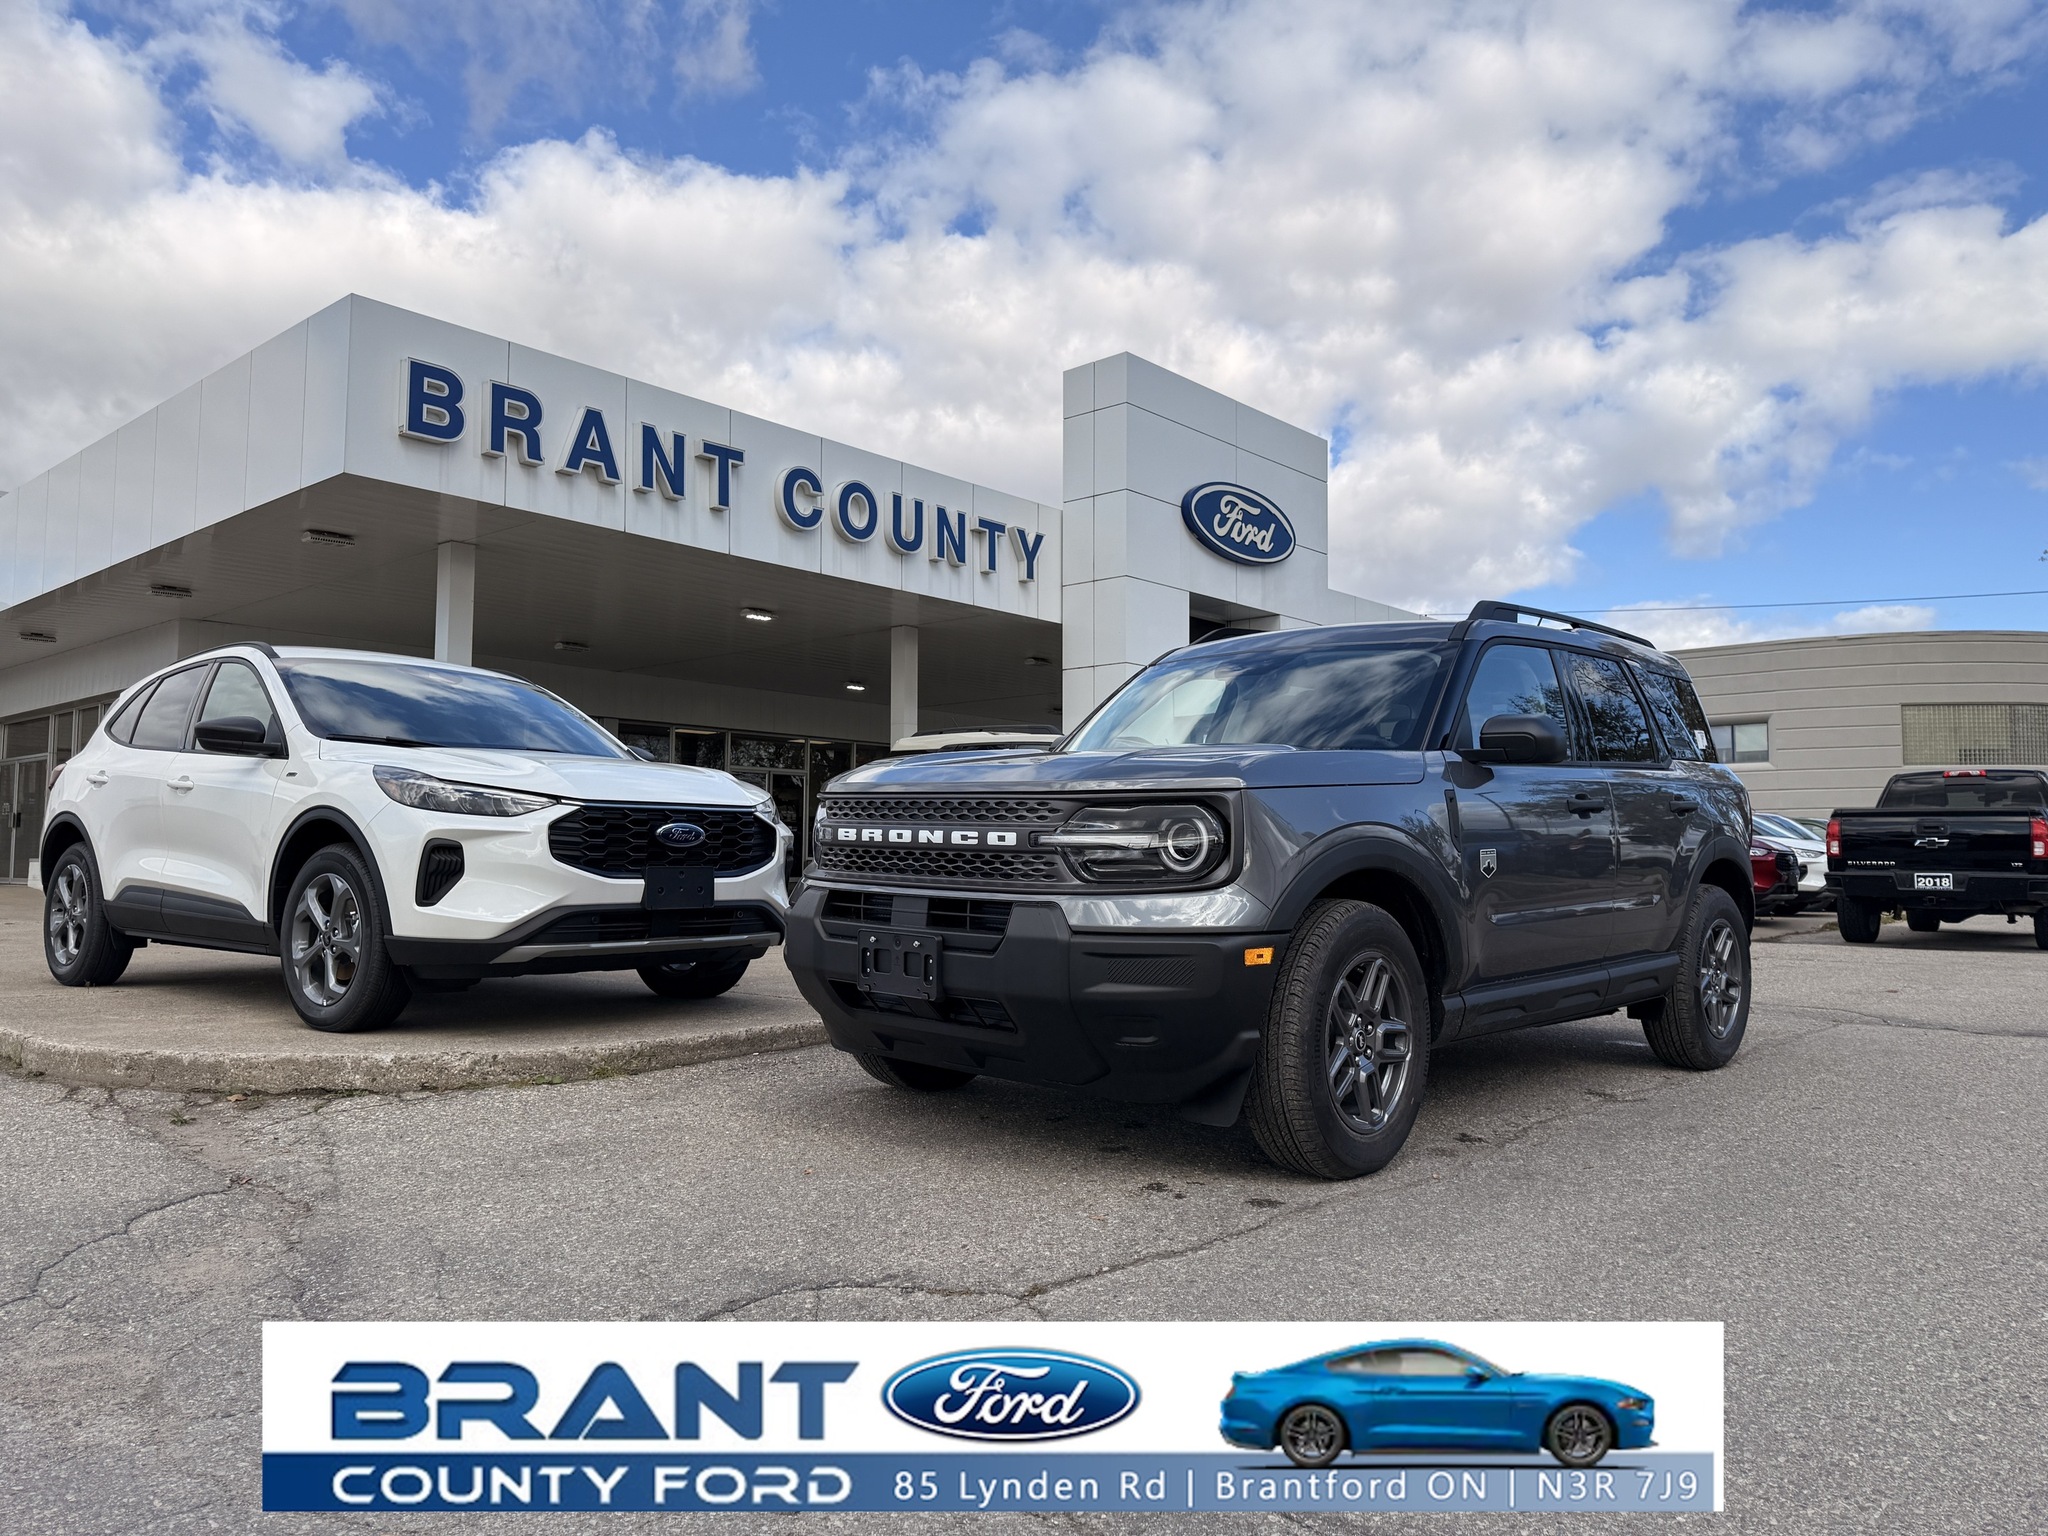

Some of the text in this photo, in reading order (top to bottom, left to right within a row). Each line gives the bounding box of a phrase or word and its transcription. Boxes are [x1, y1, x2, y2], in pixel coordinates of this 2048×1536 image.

[398, 356, 1047, 583] BRANT COUNTY
[1213, 494, 1276, 552] Ford
[837, 827, 1017, 846] BRONCO
[1917, 877, 1950, 887] 2018
